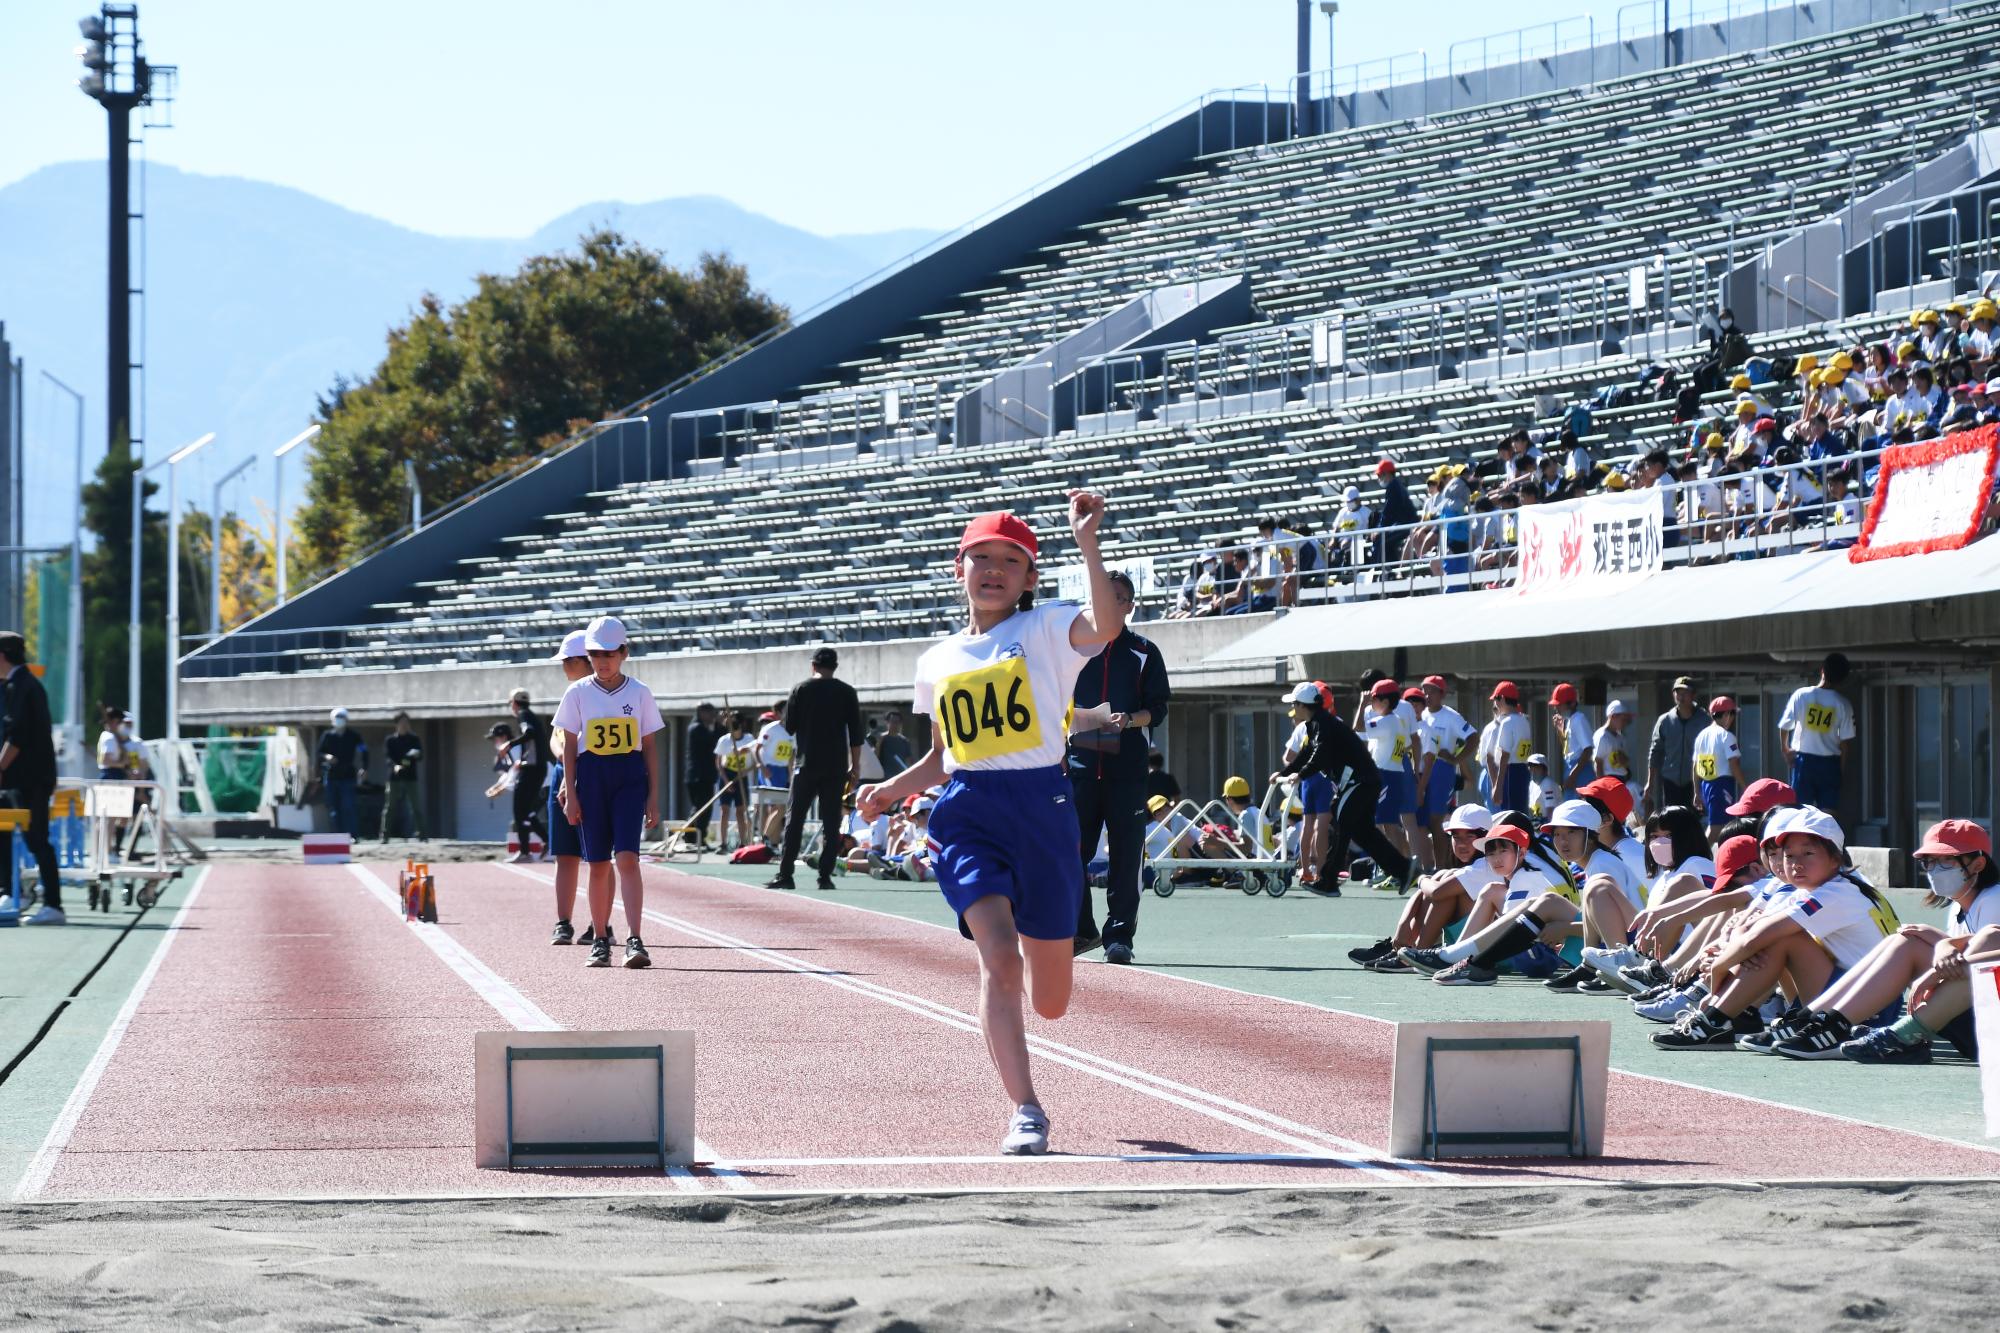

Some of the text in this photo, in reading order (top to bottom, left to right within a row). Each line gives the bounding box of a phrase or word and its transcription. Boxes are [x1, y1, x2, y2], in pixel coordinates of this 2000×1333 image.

[1593, 513, 1660, 575] 双葉西小
[940, 676, 1031, 749] 1046
[1807, 707, 1833, 729] 514
[593, 723, 633, 749] 351
